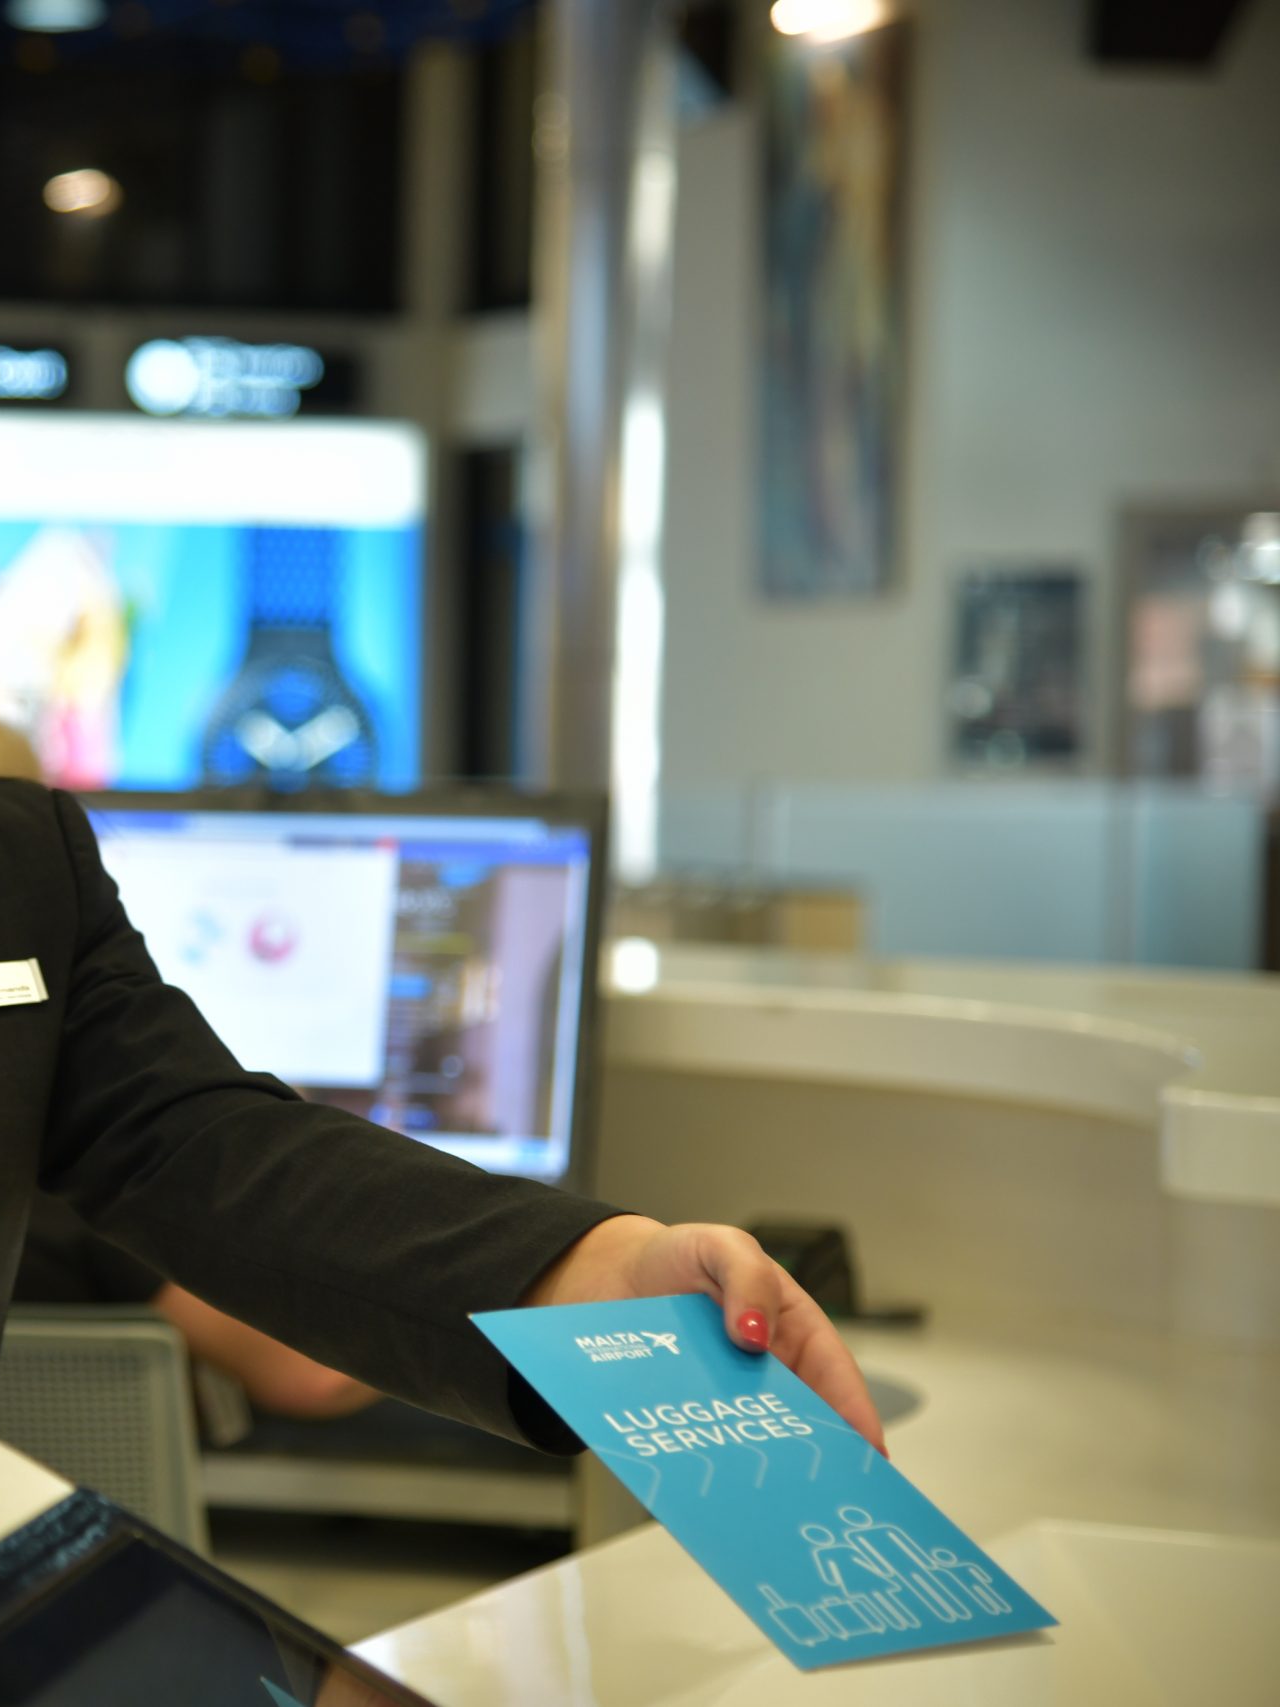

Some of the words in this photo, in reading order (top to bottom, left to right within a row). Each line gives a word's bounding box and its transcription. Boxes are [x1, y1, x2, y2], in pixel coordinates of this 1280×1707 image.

[575, 1332, 644, 1349] MALTA
[591, 1348, 654, 1363] AIRPORT
[603, 1393, 791, 1434] LUGGAGE
[626, 1415, 814, 1457] SERVICES
